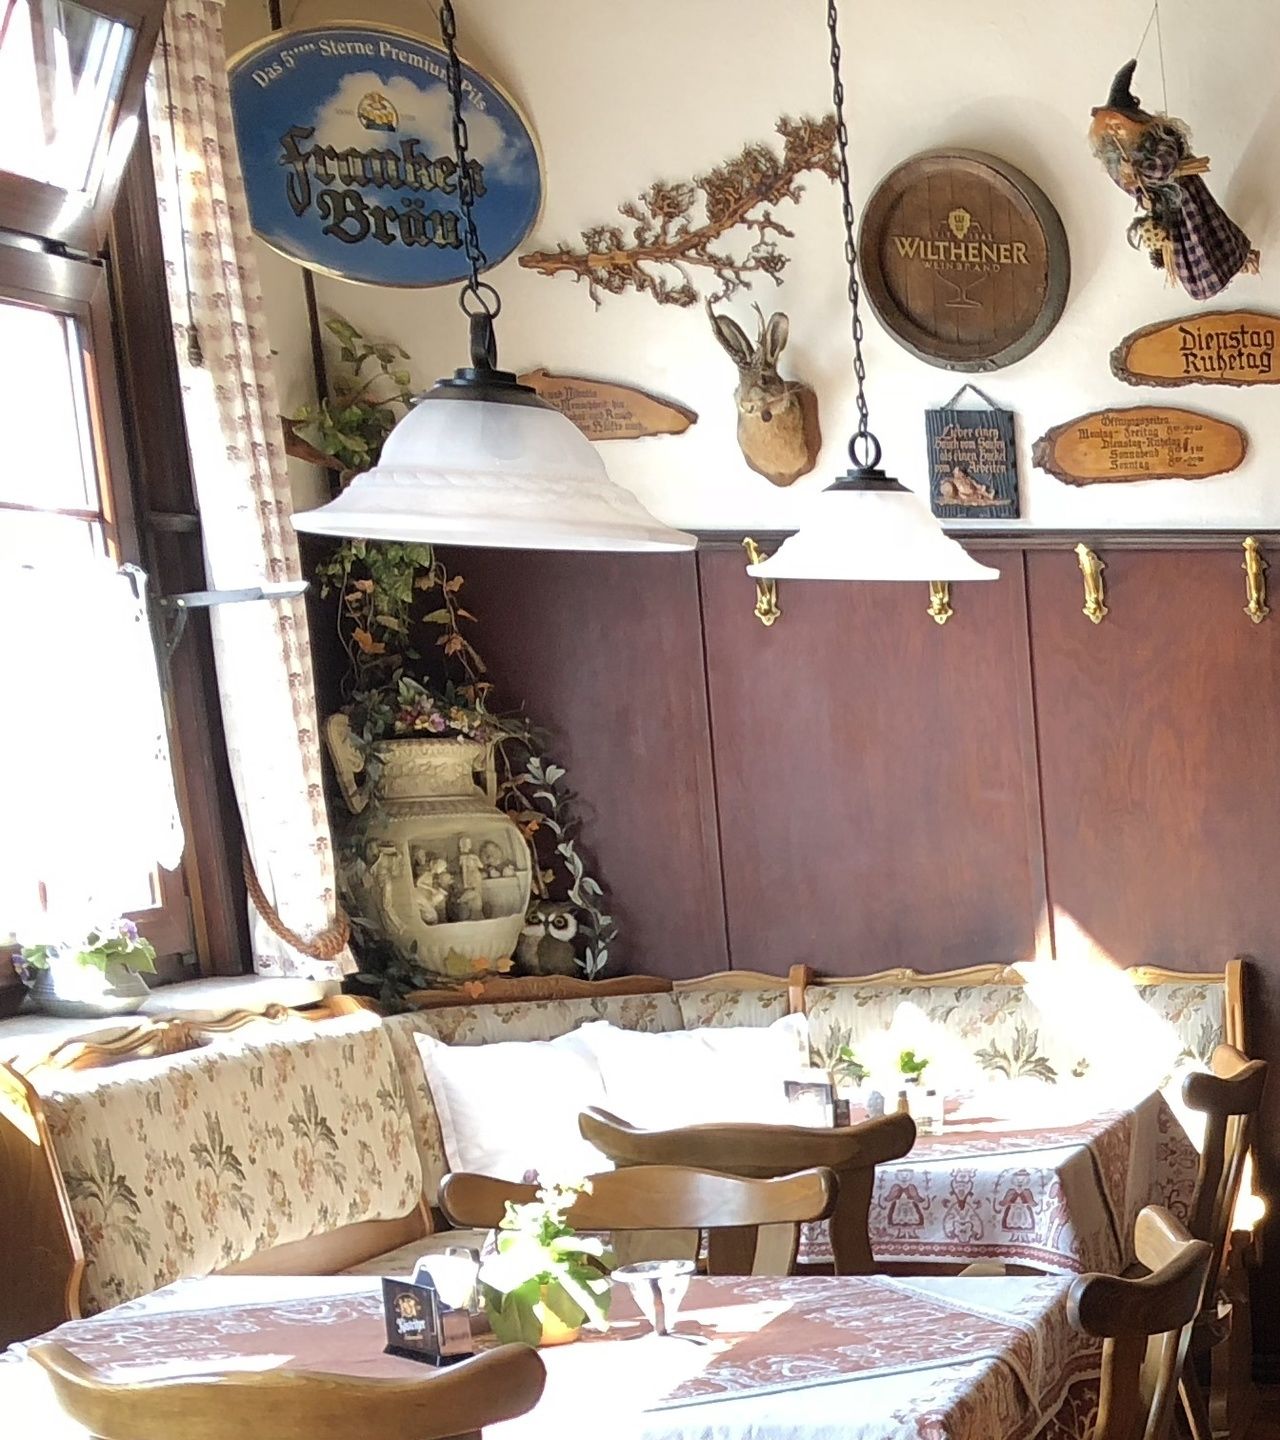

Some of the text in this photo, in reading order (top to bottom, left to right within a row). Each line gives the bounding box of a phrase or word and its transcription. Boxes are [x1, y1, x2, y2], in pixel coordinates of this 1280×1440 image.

[252, 61, 283, 88] Das
[320, 39, 374, 57] Sterne
[461, 79, 487, 110] Pils
[280, 125, 487, 217] Franken
[316, 189, 463, 249] Bräu
[891, 235, 1030, 265] WILTHENER
[1178, 324, 1275, 351] Dienstag
[1182, 348, 1272, 378] Ruhetag
